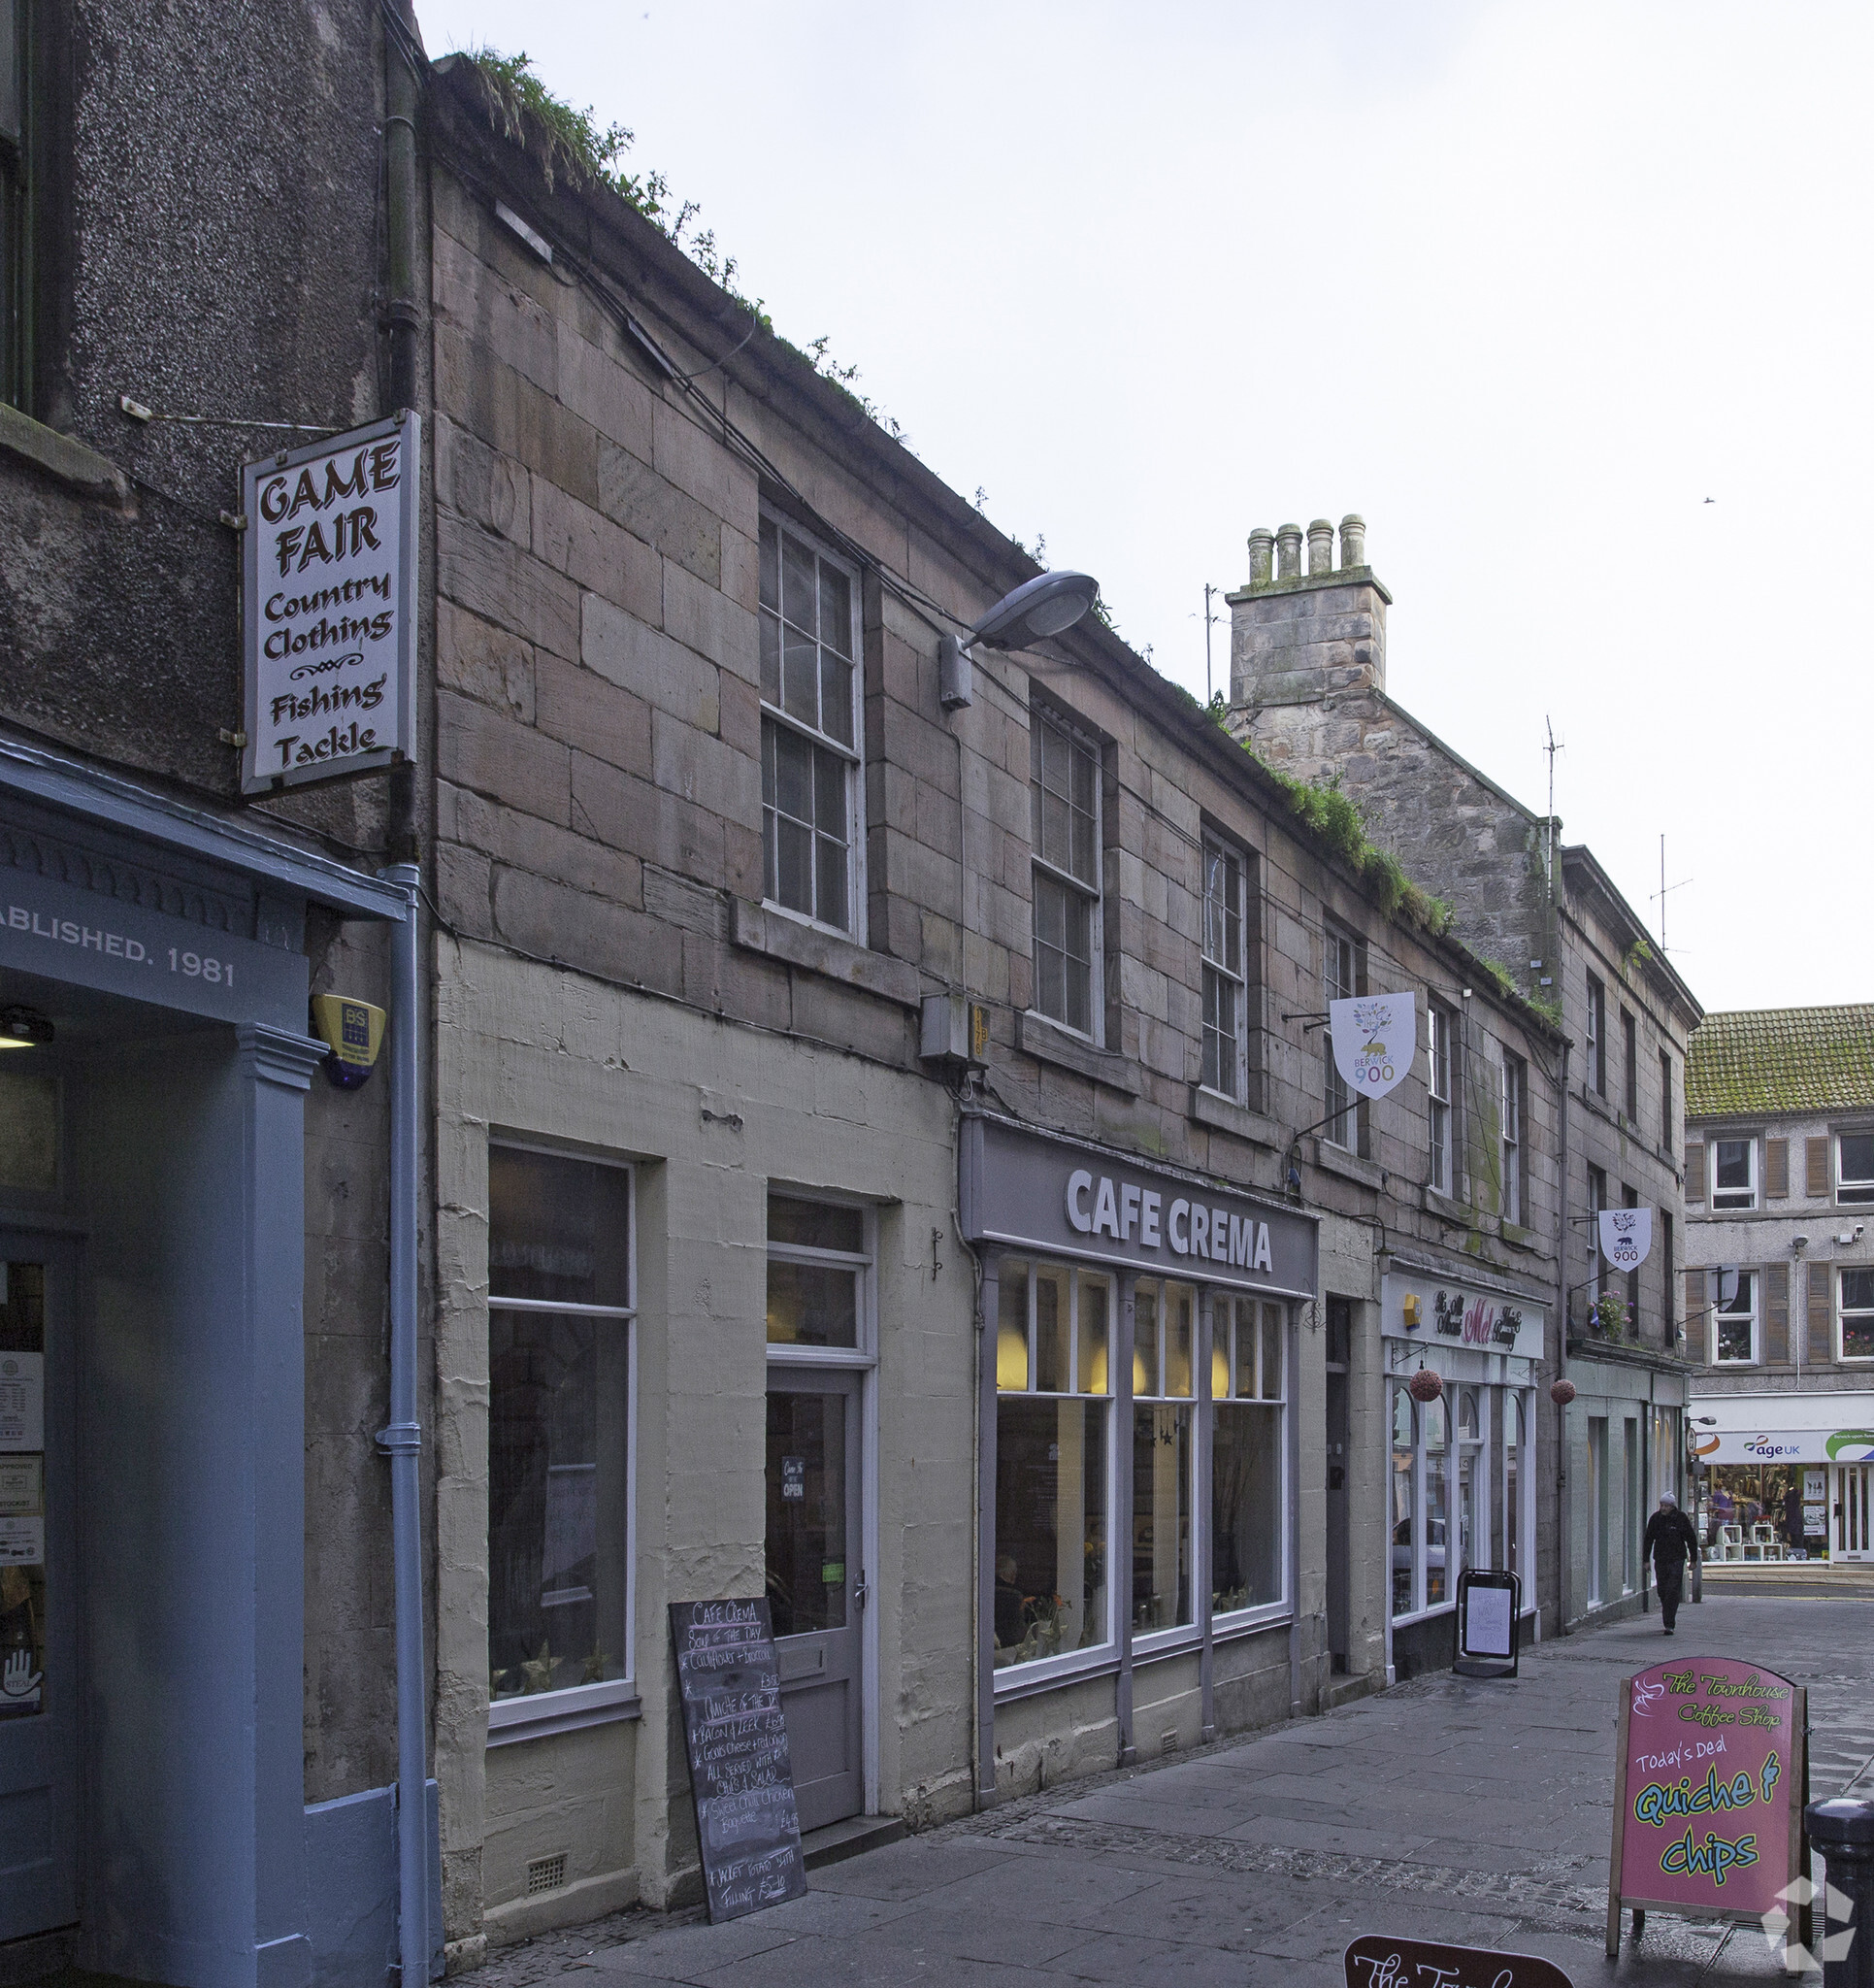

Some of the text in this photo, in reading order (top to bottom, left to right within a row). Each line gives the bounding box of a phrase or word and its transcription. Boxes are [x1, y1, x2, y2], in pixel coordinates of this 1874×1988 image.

[260, 440, 401, 524] GAME
[275, 506, 381, 578] FAIR
[264, 572, 391, 623] Country
[264, 610, 394, 661] Clothing
[270, 677, 387, 726] Fishing
[274, 721, 377, 769] Tackle
[169, 947, 234, 987] 1981
[1354, 1055, 1395, 1068] BERWICK
[1355, 1065, 1395, 1084] 900
[1066, 1169, 1273, 1273] CAFE CREMA
[1613, 1251, 1638, 1262] 900
[1756, 1445, 1800, 1458] age UK
[783, 1482, 804, 1498] OPEN
[726, 1599, 757, 1623] CREMA
[743, 1626, 762, 1641] DAY
[1662, 1670, 1790, 1700] The Townhouse
[1678, 1704, 1781, 1732] Coffee Shop
[1635, 1734, 1727, 1773] Today's Deal
[1633, 1761, 1758, 1828] Quiche
[1353, 1953, 1409, 1988] The
